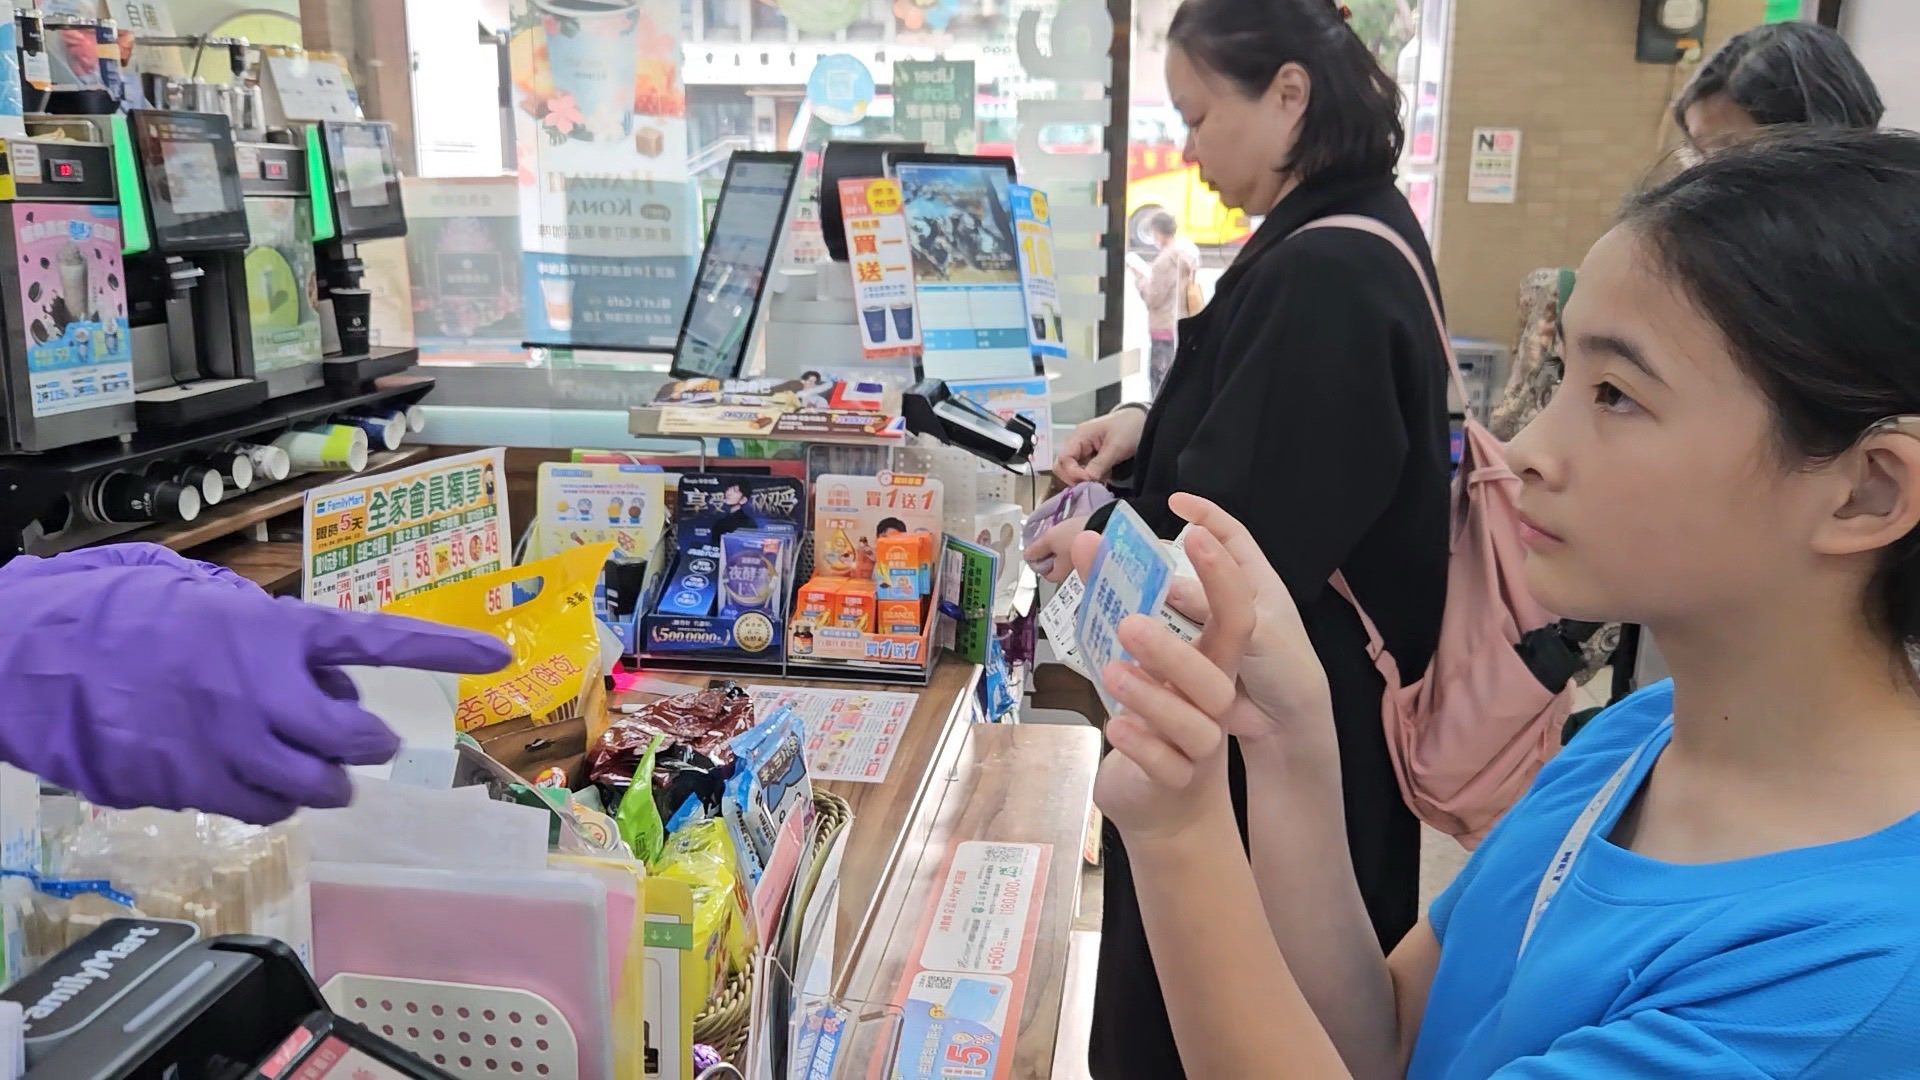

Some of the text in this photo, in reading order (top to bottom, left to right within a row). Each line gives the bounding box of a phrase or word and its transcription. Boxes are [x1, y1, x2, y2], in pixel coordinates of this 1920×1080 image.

[326, 494, 364, 511] FamilyMart
[367, 468, 482, 532] 全家會員獨享
[866, 487, 934, 509] 買1送1
[451, 541, 465, 568] 59
[485, 531, 498, 554] 49
[415, 551, 431, 579] 58
[488, 587, 501, 614] 56
[865, 639, 920, 660] 買1送1
